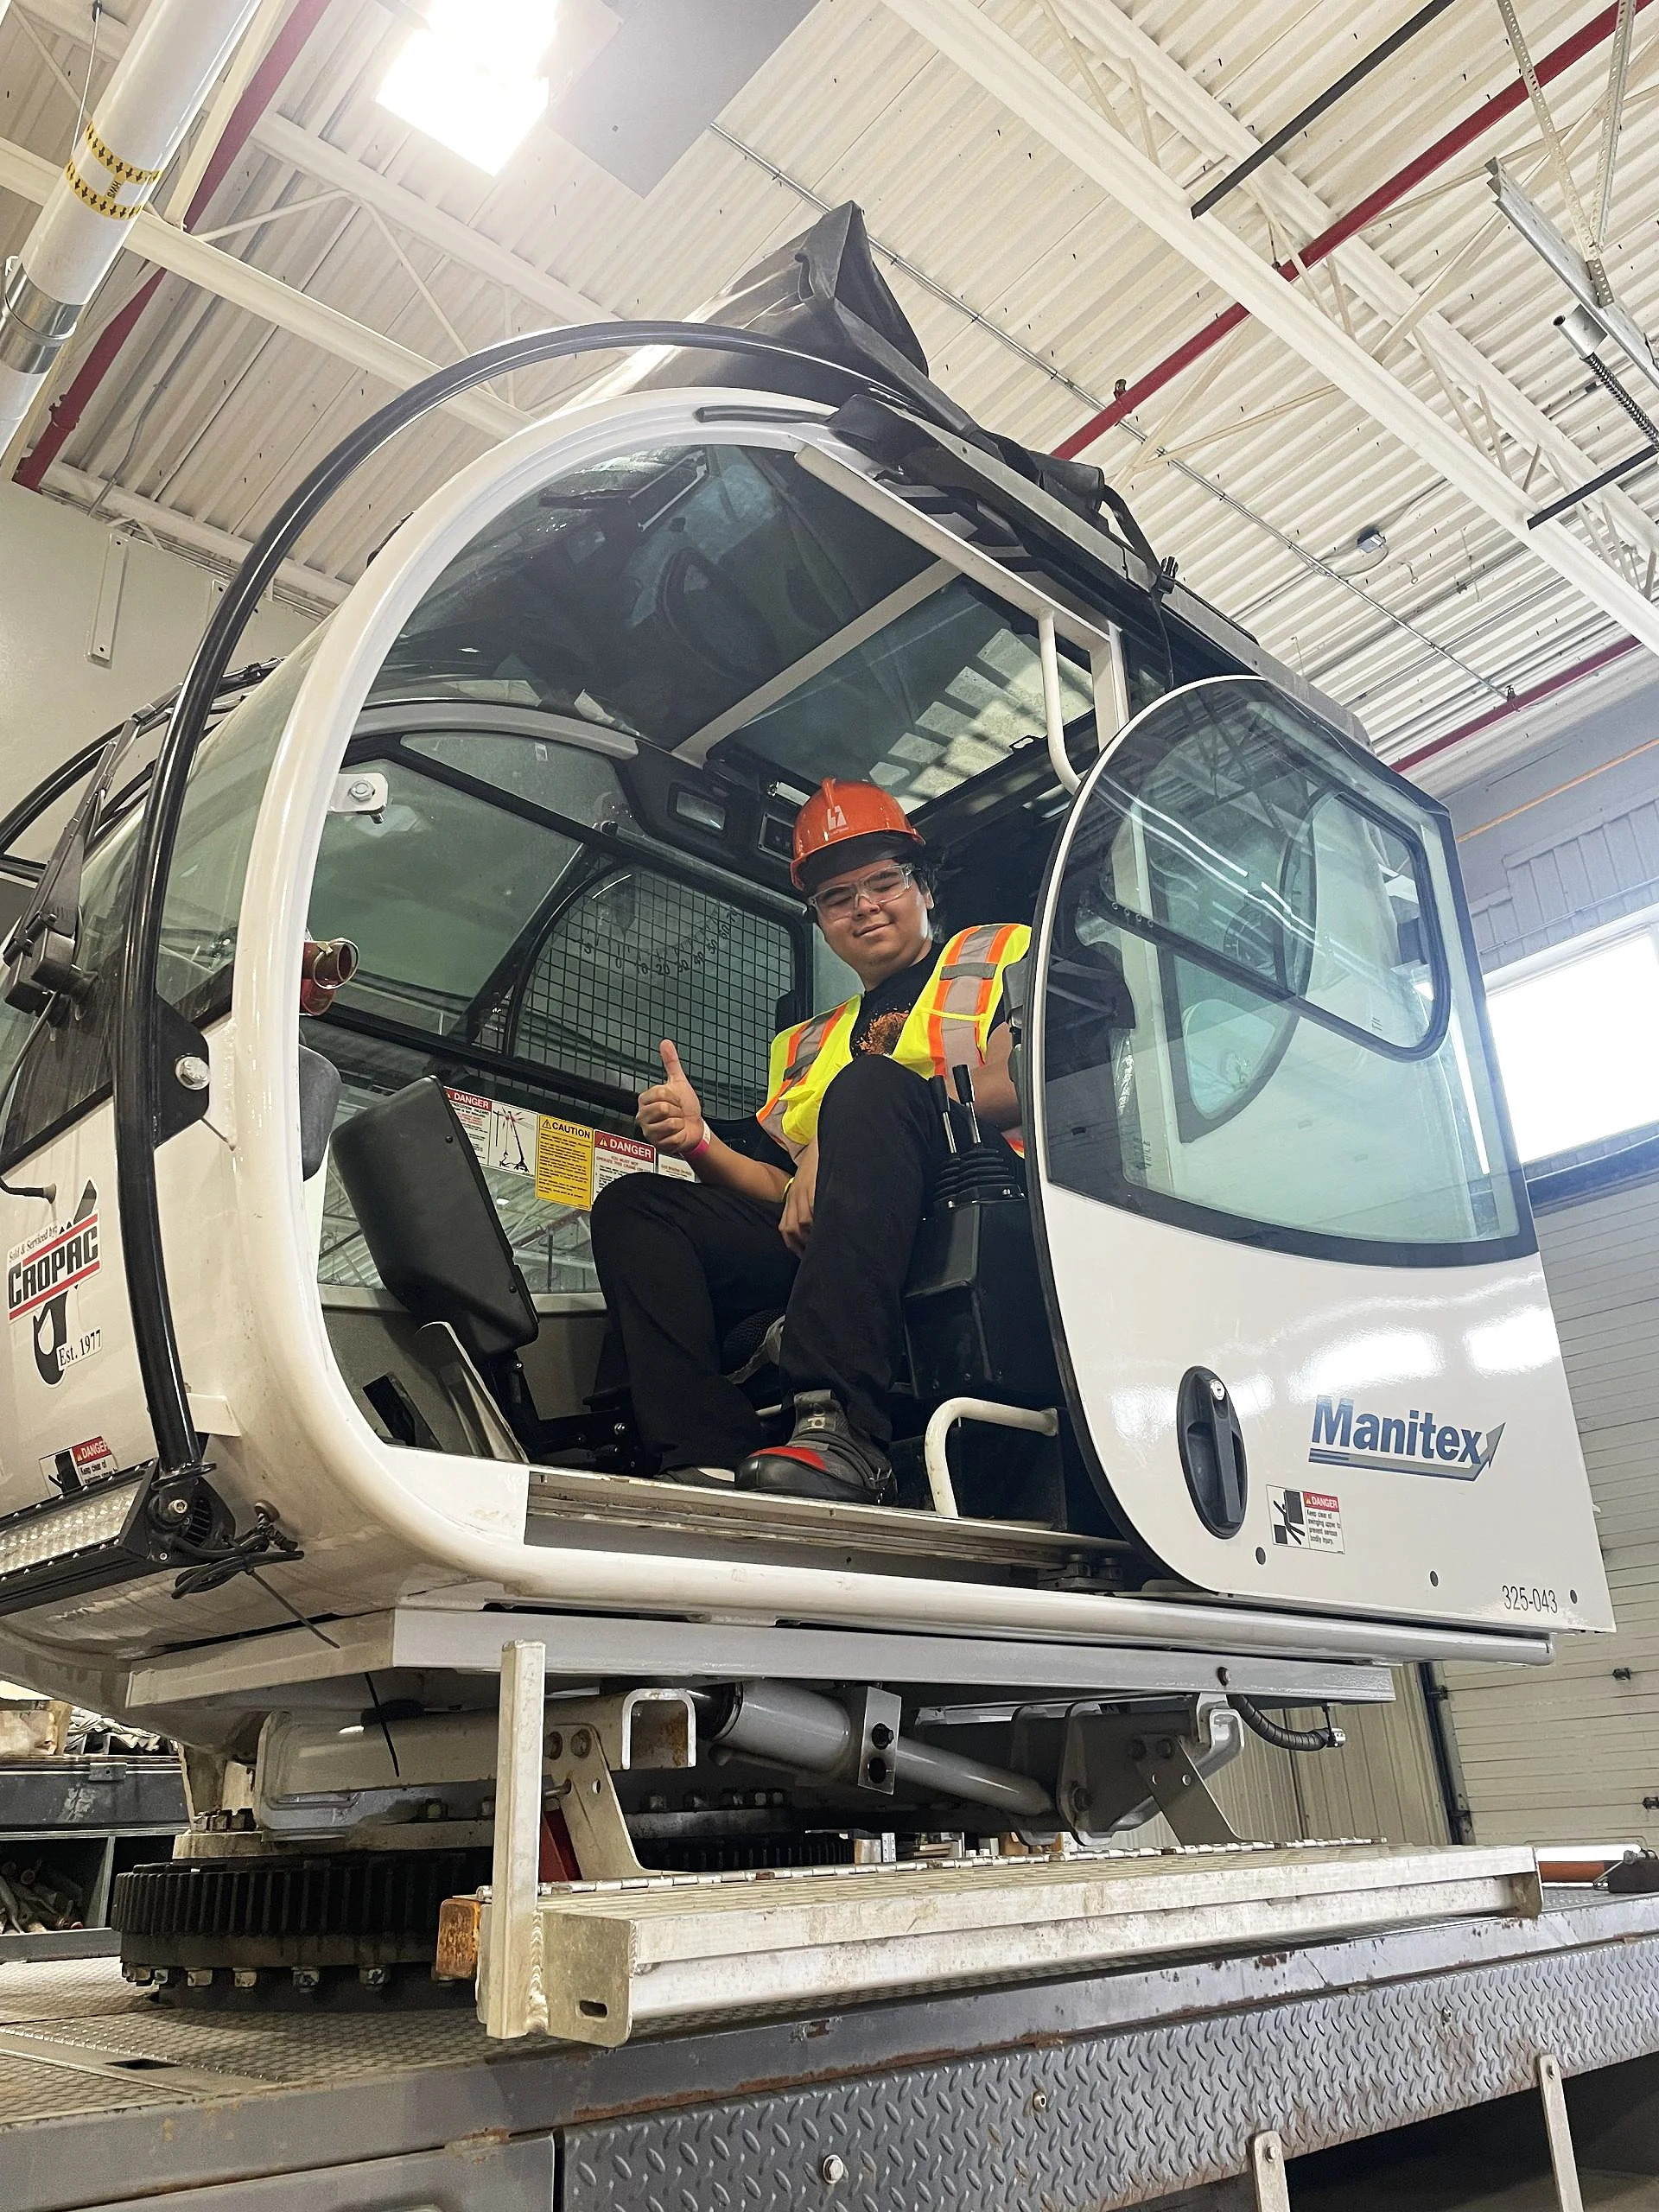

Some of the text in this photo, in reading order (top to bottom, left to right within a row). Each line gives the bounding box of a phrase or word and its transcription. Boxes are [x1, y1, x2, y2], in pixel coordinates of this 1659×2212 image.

[454, 1092, 490, 1109] DANGER
[551, 1122, 591, 1140] CAUTION
[609, 1138, 652, 1160] DANGER
[9, 1226, 99, 1310] CROPAC
[59, 1329, 101, 1366] Est. 1977
[1312, 1395, 1482, 1465] Manitex
[1311, 1496, 1338, 1509] DANGER
[1502, 1585, 1559, 1614] 325-043
